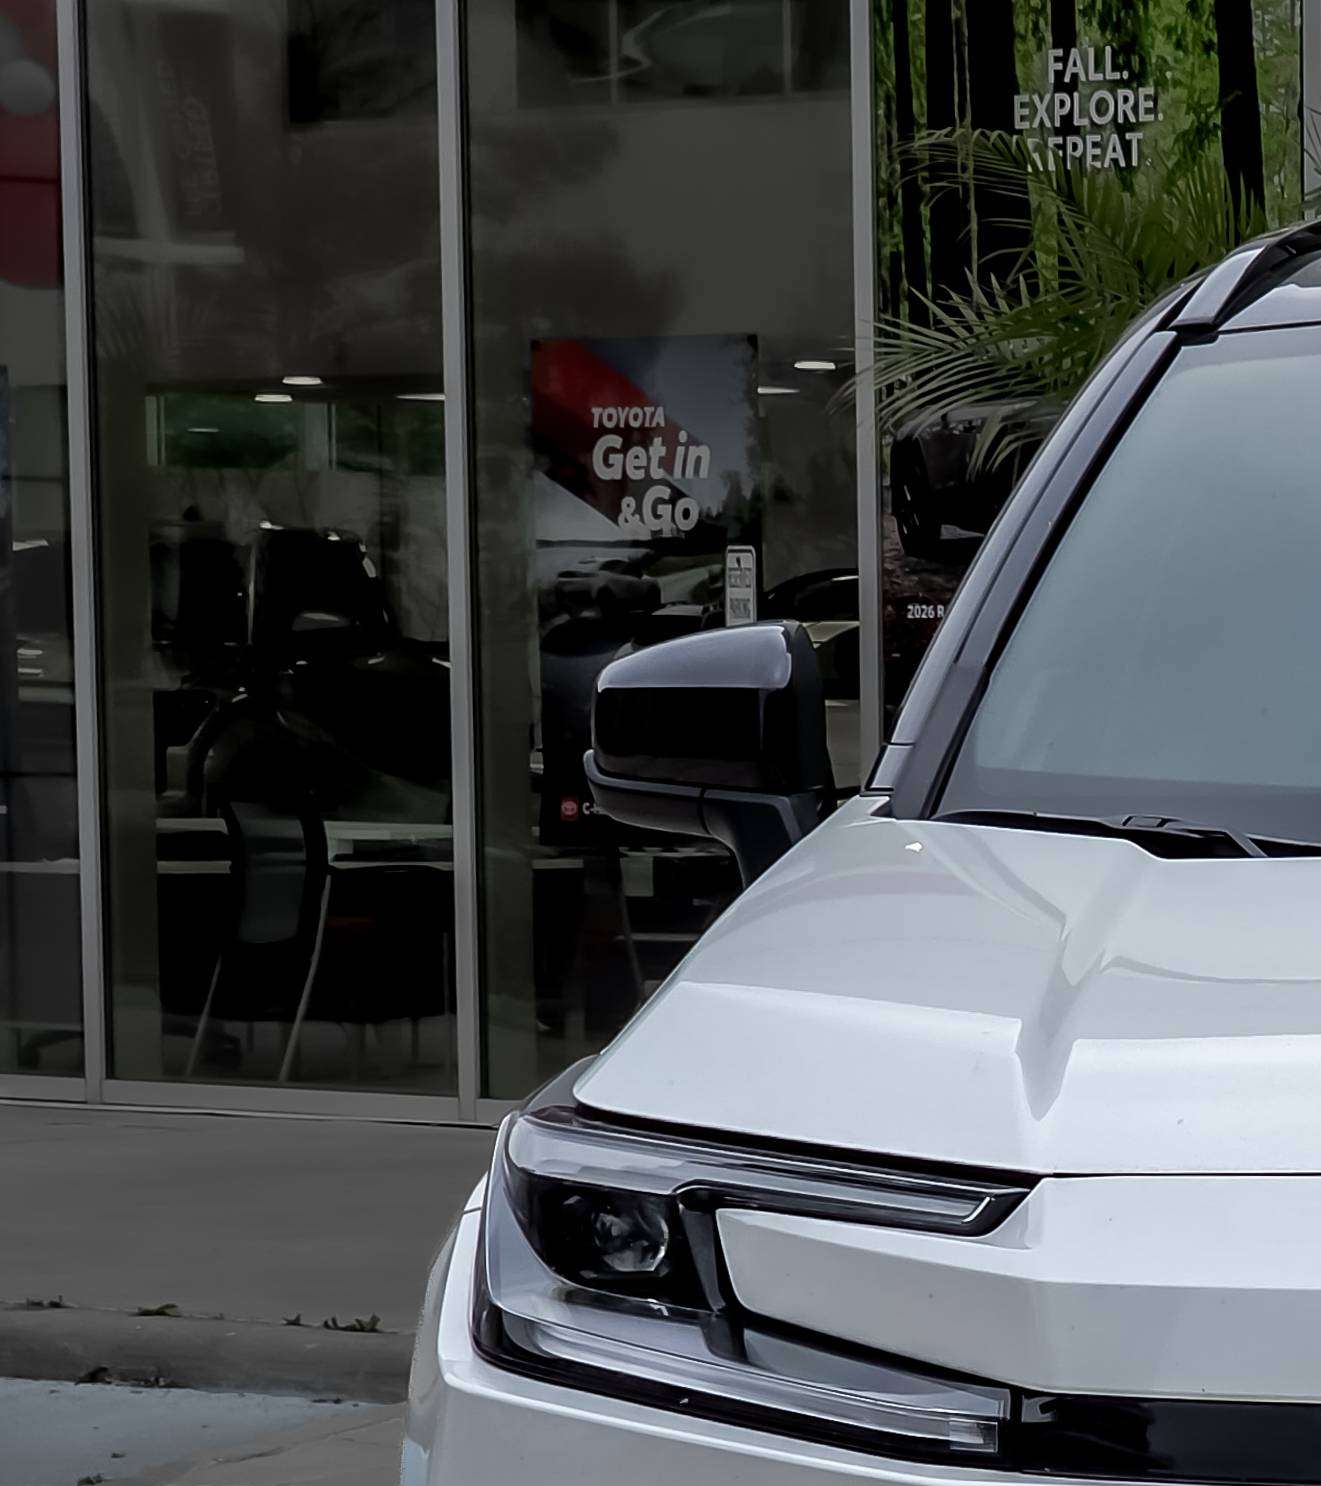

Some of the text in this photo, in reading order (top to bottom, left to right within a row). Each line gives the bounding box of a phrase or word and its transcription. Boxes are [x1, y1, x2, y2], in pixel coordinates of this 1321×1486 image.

[1047, 45, 1129, 84] FALL.
[1013, 87, 1164, 130] EXPLORE.
[591, 406, 665, 429] TOYOTA
[592, 430, 711, 480] Get in
[906, 603, 936, 620] 2026
